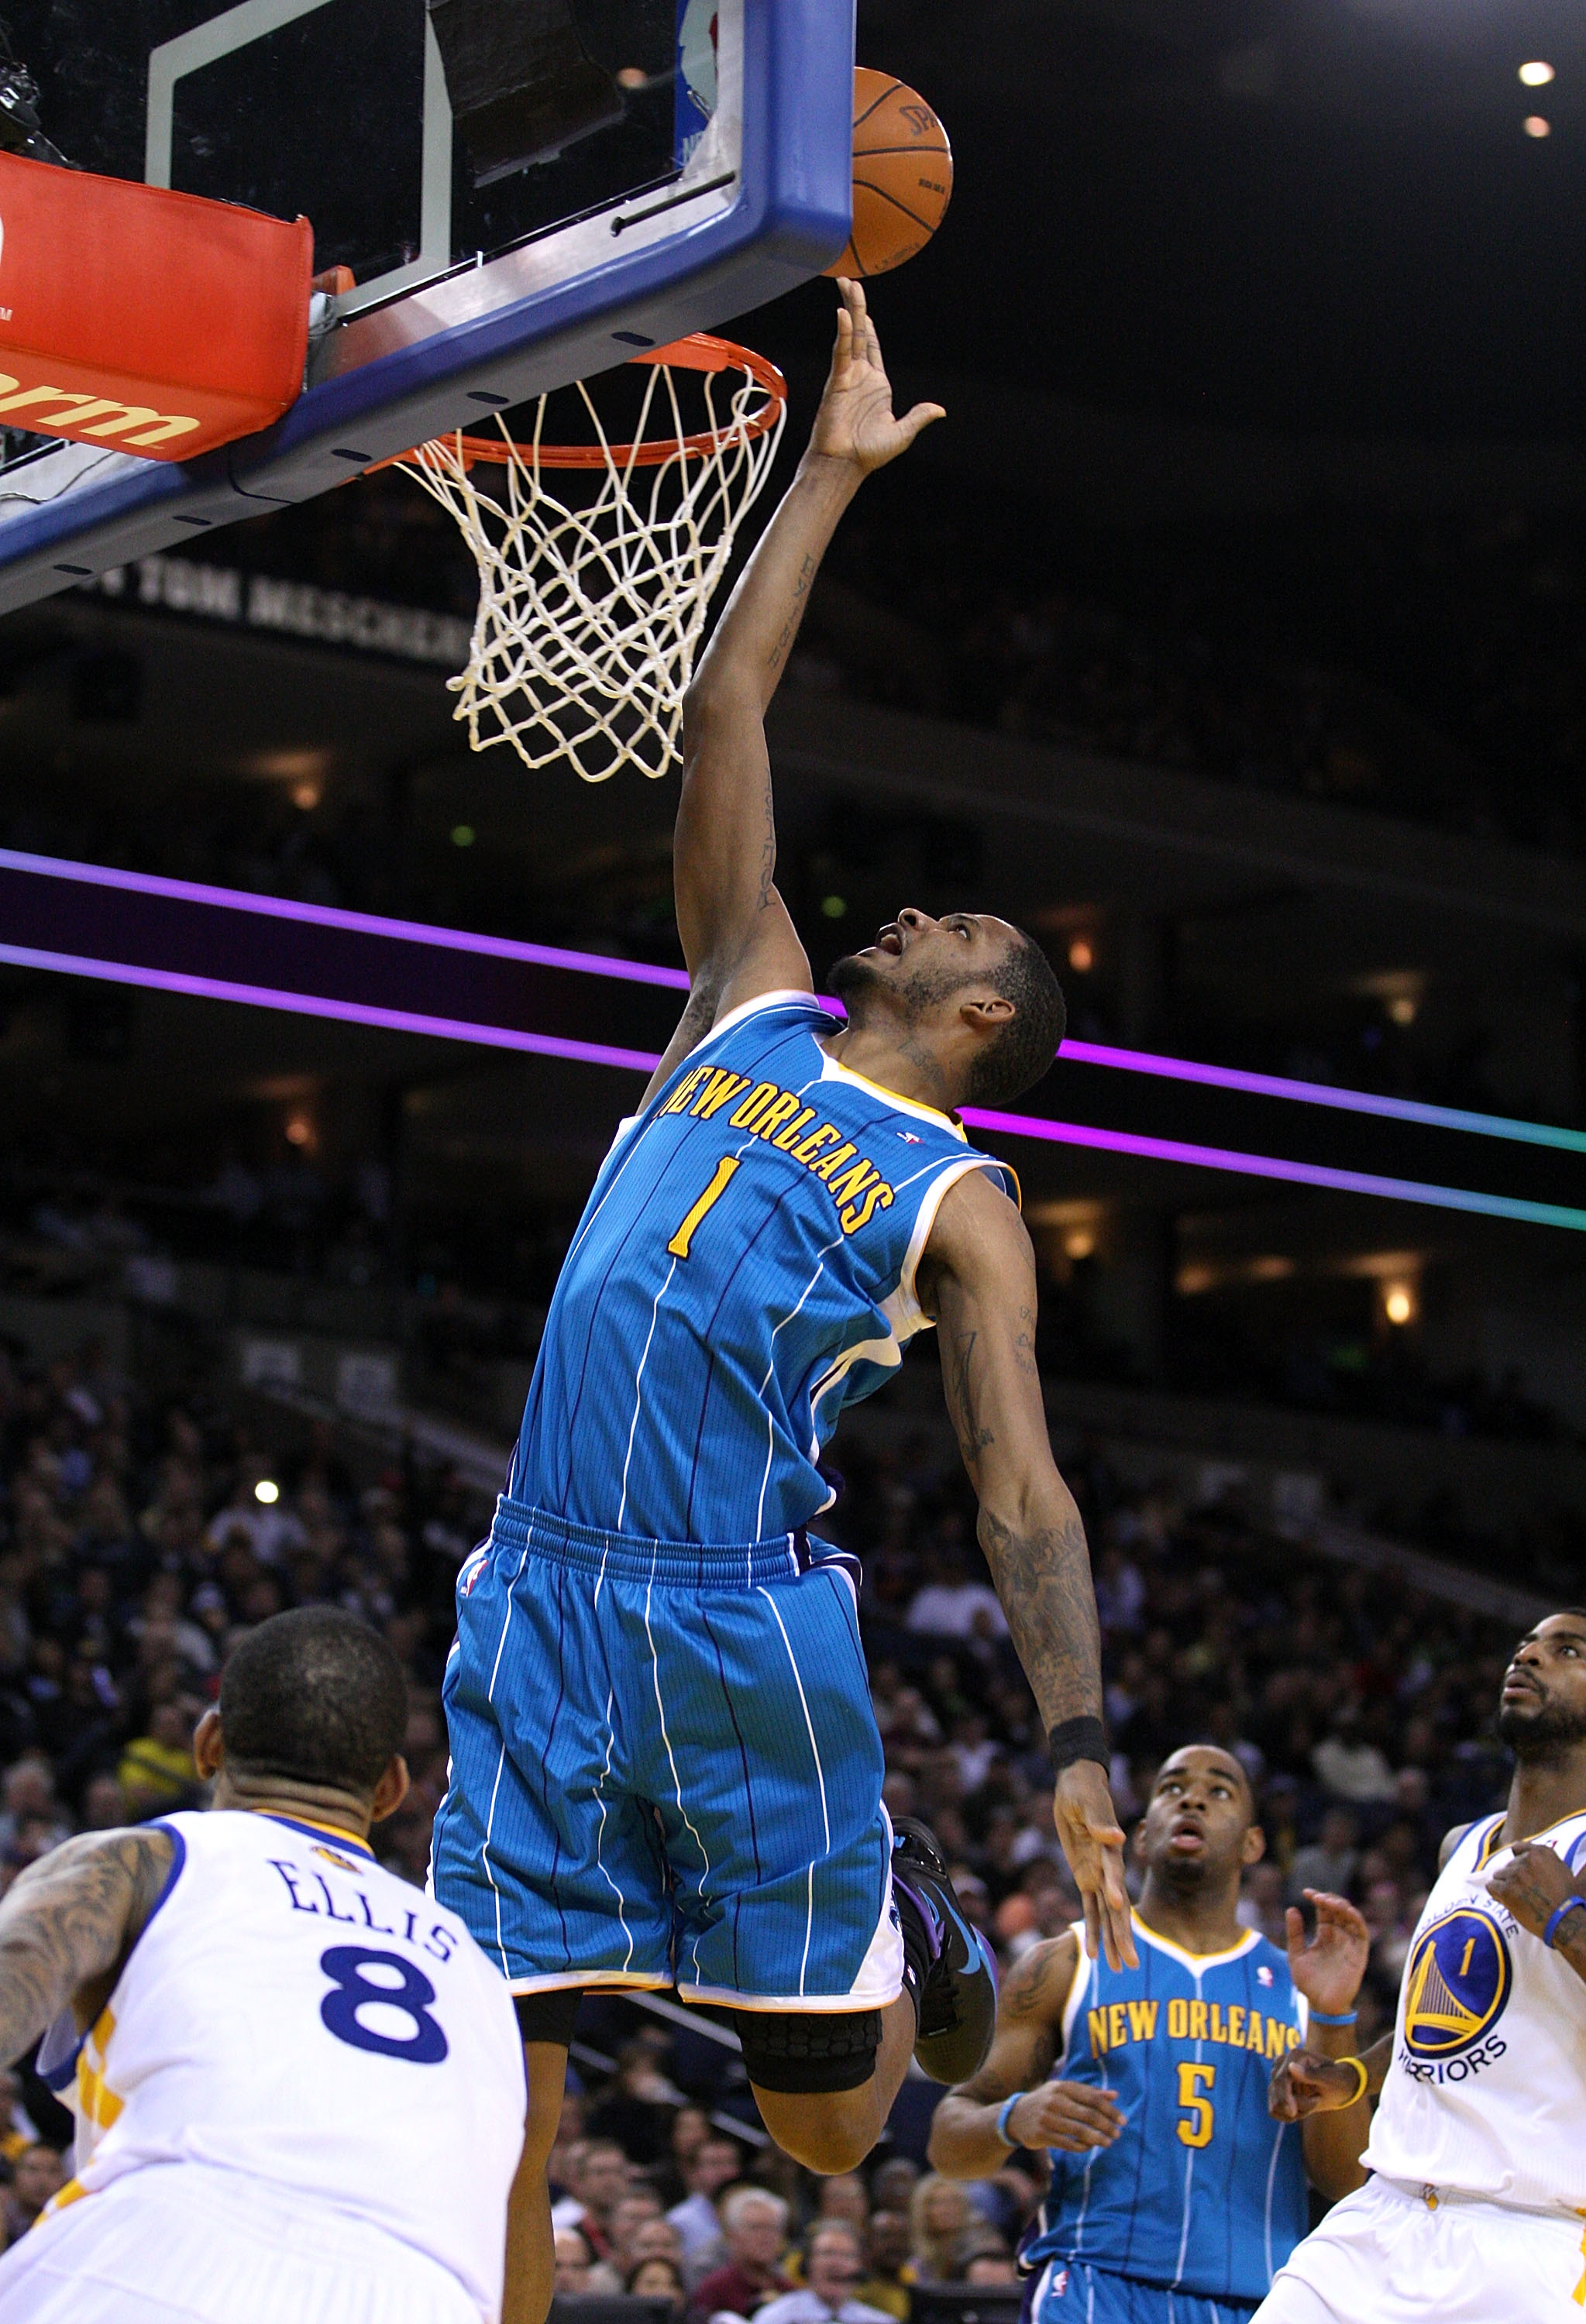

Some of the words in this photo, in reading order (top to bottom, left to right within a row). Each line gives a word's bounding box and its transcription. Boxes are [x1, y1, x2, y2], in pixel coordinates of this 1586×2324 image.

[652, 1066, 752, 1120] NEW
[728, 1081, 895, 1235] ORLEANS
[667, 1155, 740, 1258] 1
[267, 1858, 459, 1962] ELLIS
[1459, 1937, 1477, 1976] 1
[320, 1945, 449, 2064] 8
[1087, 1999, 1160, 2060] NEW
[1175, 2061, 1217, 2150] 5
